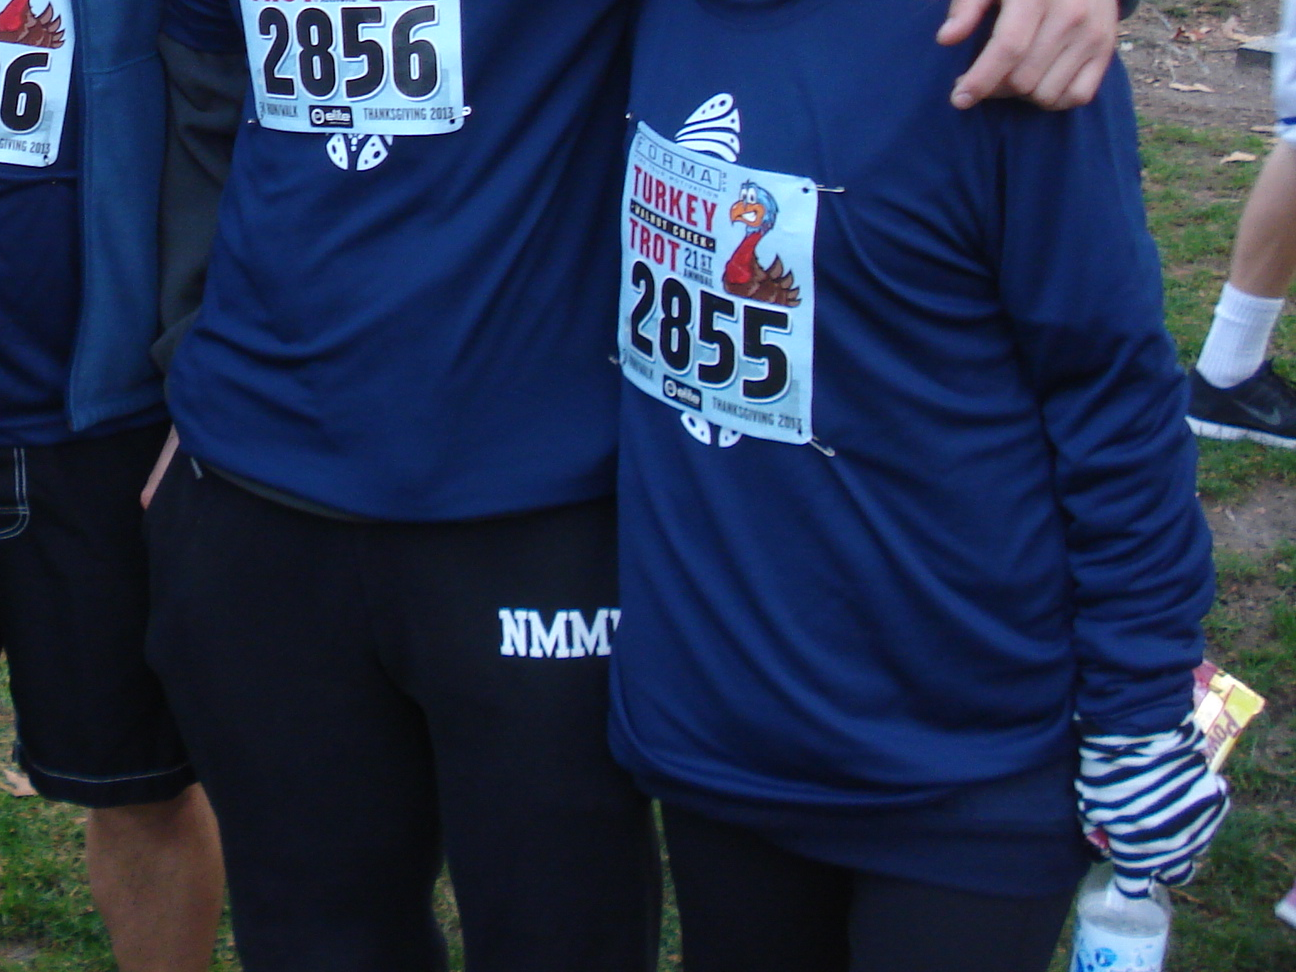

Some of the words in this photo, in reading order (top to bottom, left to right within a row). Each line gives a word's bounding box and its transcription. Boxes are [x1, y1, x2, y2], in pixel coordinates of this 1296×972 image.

[259, 4, 439, 99] 2856
[363, 107, 427, 121] THANKSGIVING
[430, 106, 454, 121] 2013
[29, 141, 52, 156] 2013
[636, 135, 712, 185] FORMA
[634, 164, 717, 233] TURKEY
[630, 216, 681, 272] TROT
[672, 225, 707, 248] CREEK
[630, 260, 790, 403] 2855
